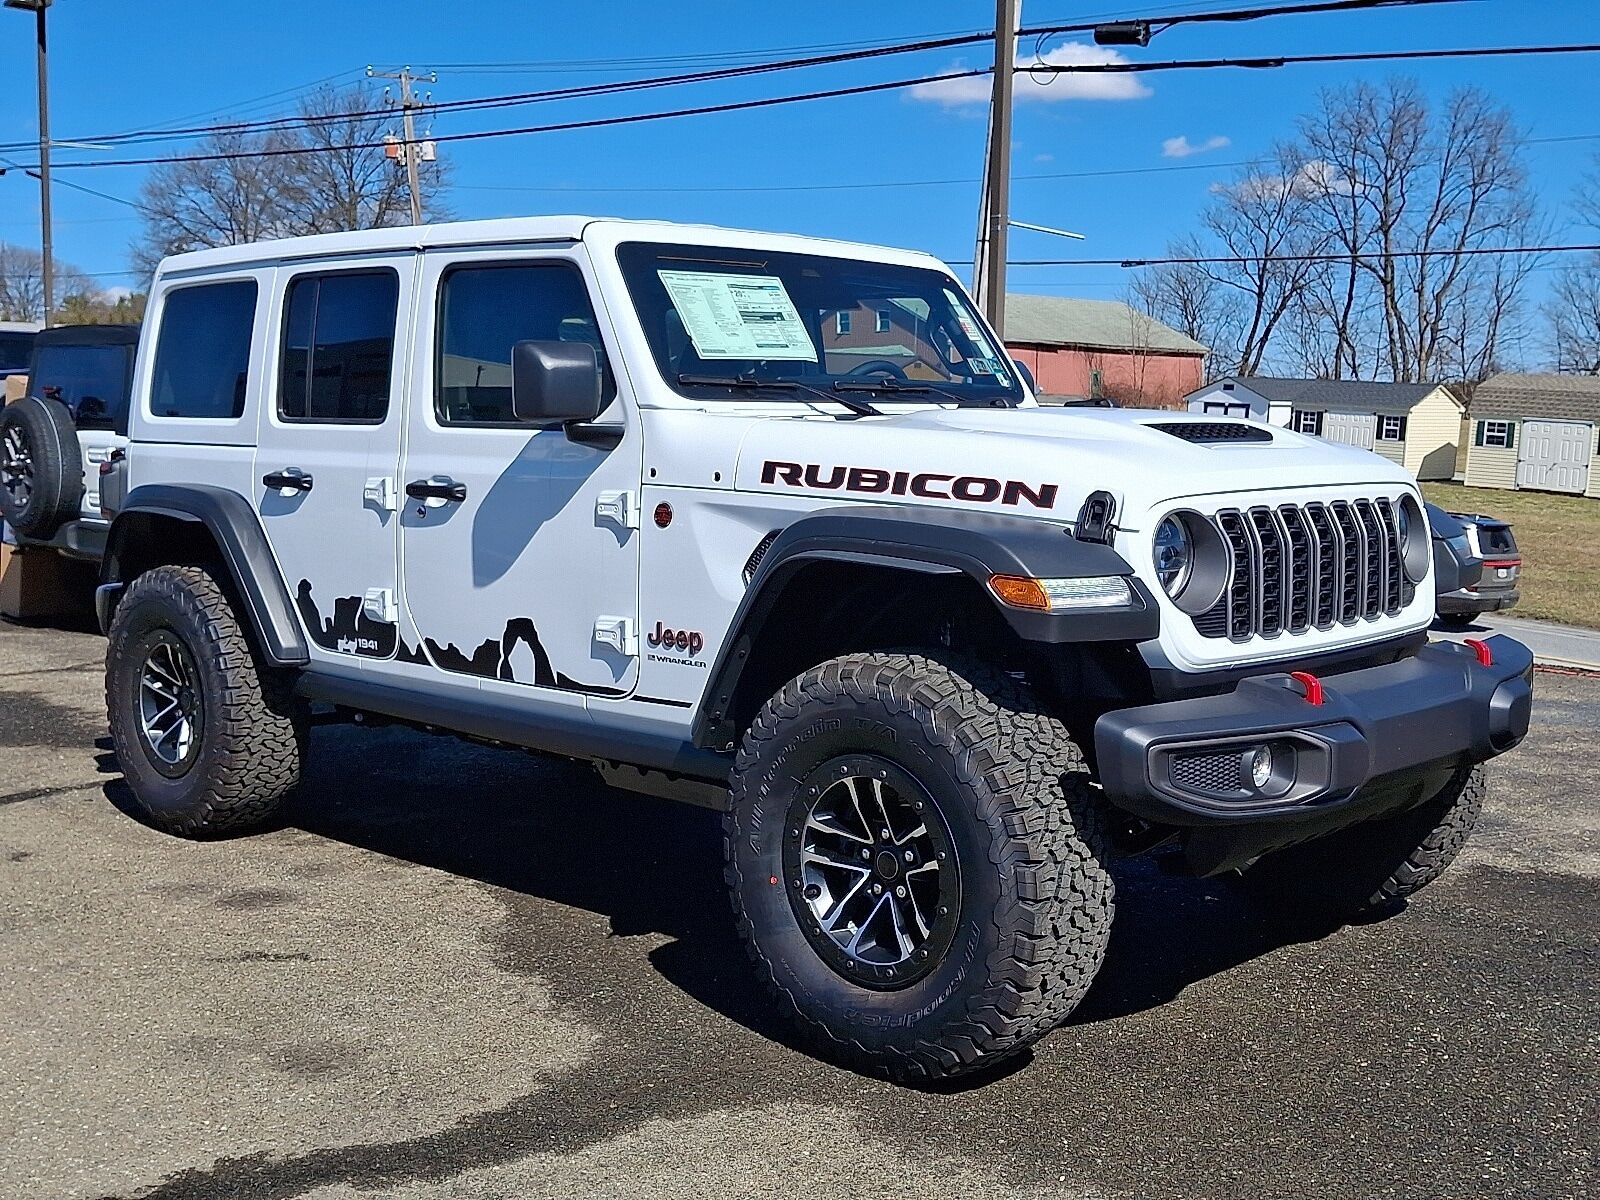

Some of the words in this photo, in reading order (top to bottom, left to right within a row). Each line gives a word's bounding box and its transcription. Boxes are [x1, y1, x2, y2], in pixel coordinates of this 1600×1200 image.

[760, 460, 1058, 509] RUBICON
[358, 638, 378, 650] 1941
[647, 621, 703, 658] Jeep
[656, 655, 707, 668] WRANGLER
